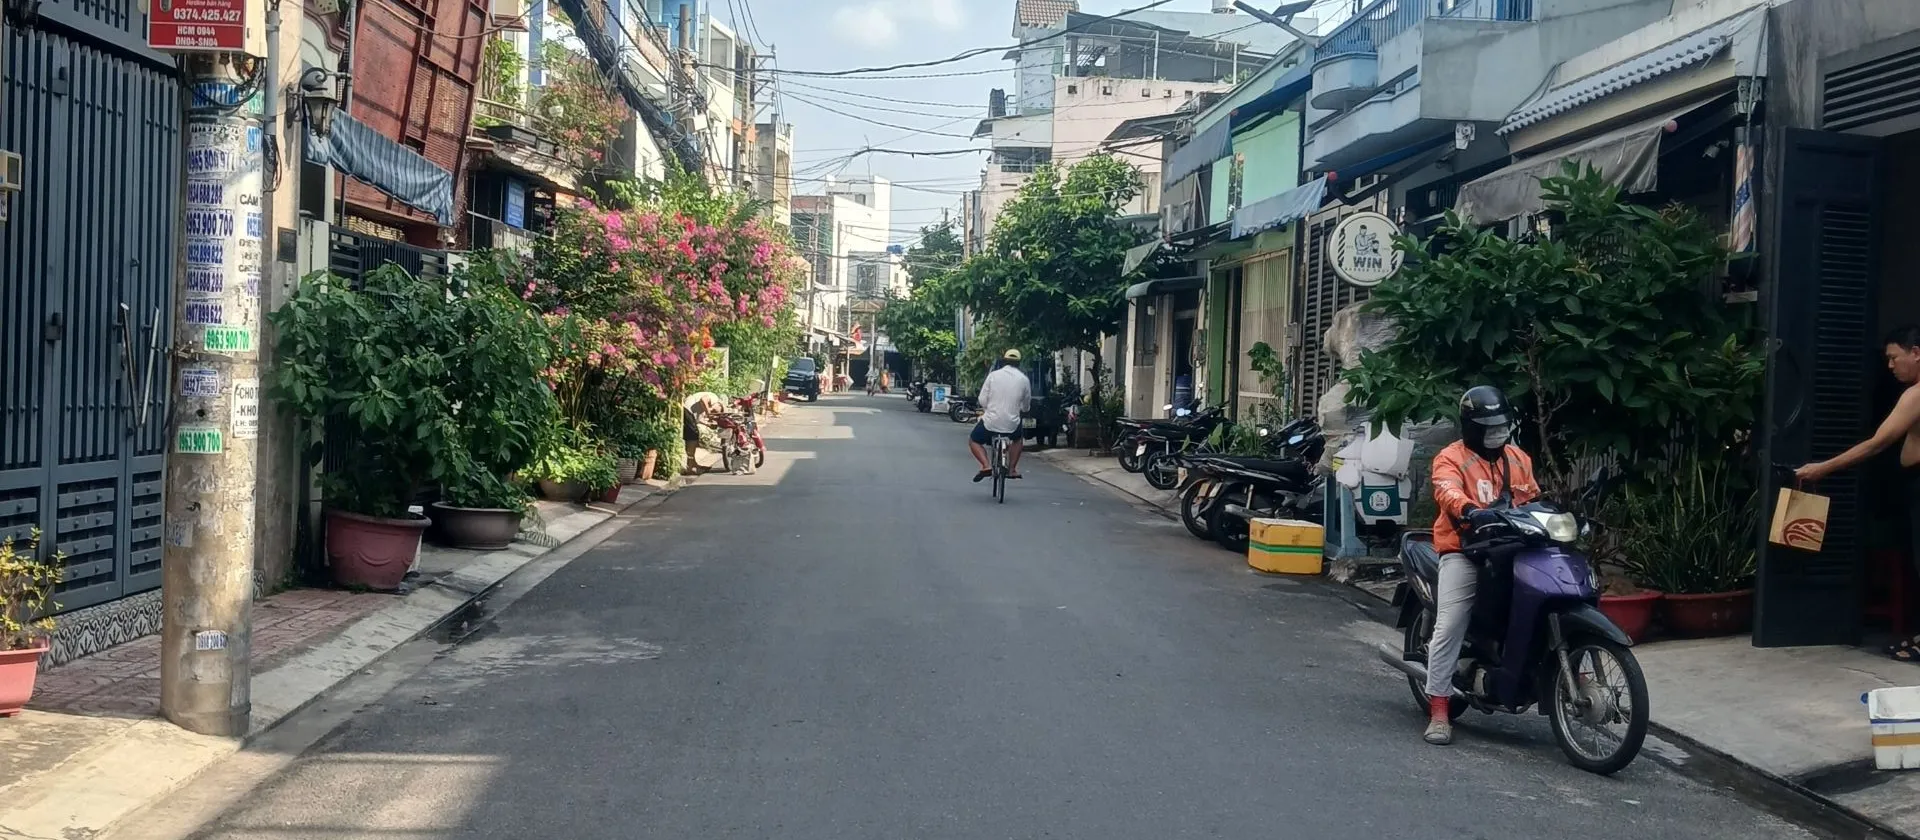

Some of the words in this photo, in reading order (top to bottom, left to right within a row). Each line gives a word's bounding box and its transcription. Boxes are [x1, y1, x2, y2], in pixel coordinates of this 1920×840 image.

[174, 8, 242, 21] 0374.425.427
[177, 26, 195, 35] HCM
[196, 27, 215, 36] 0944
[1353, 256, 1383, 269] WIN
